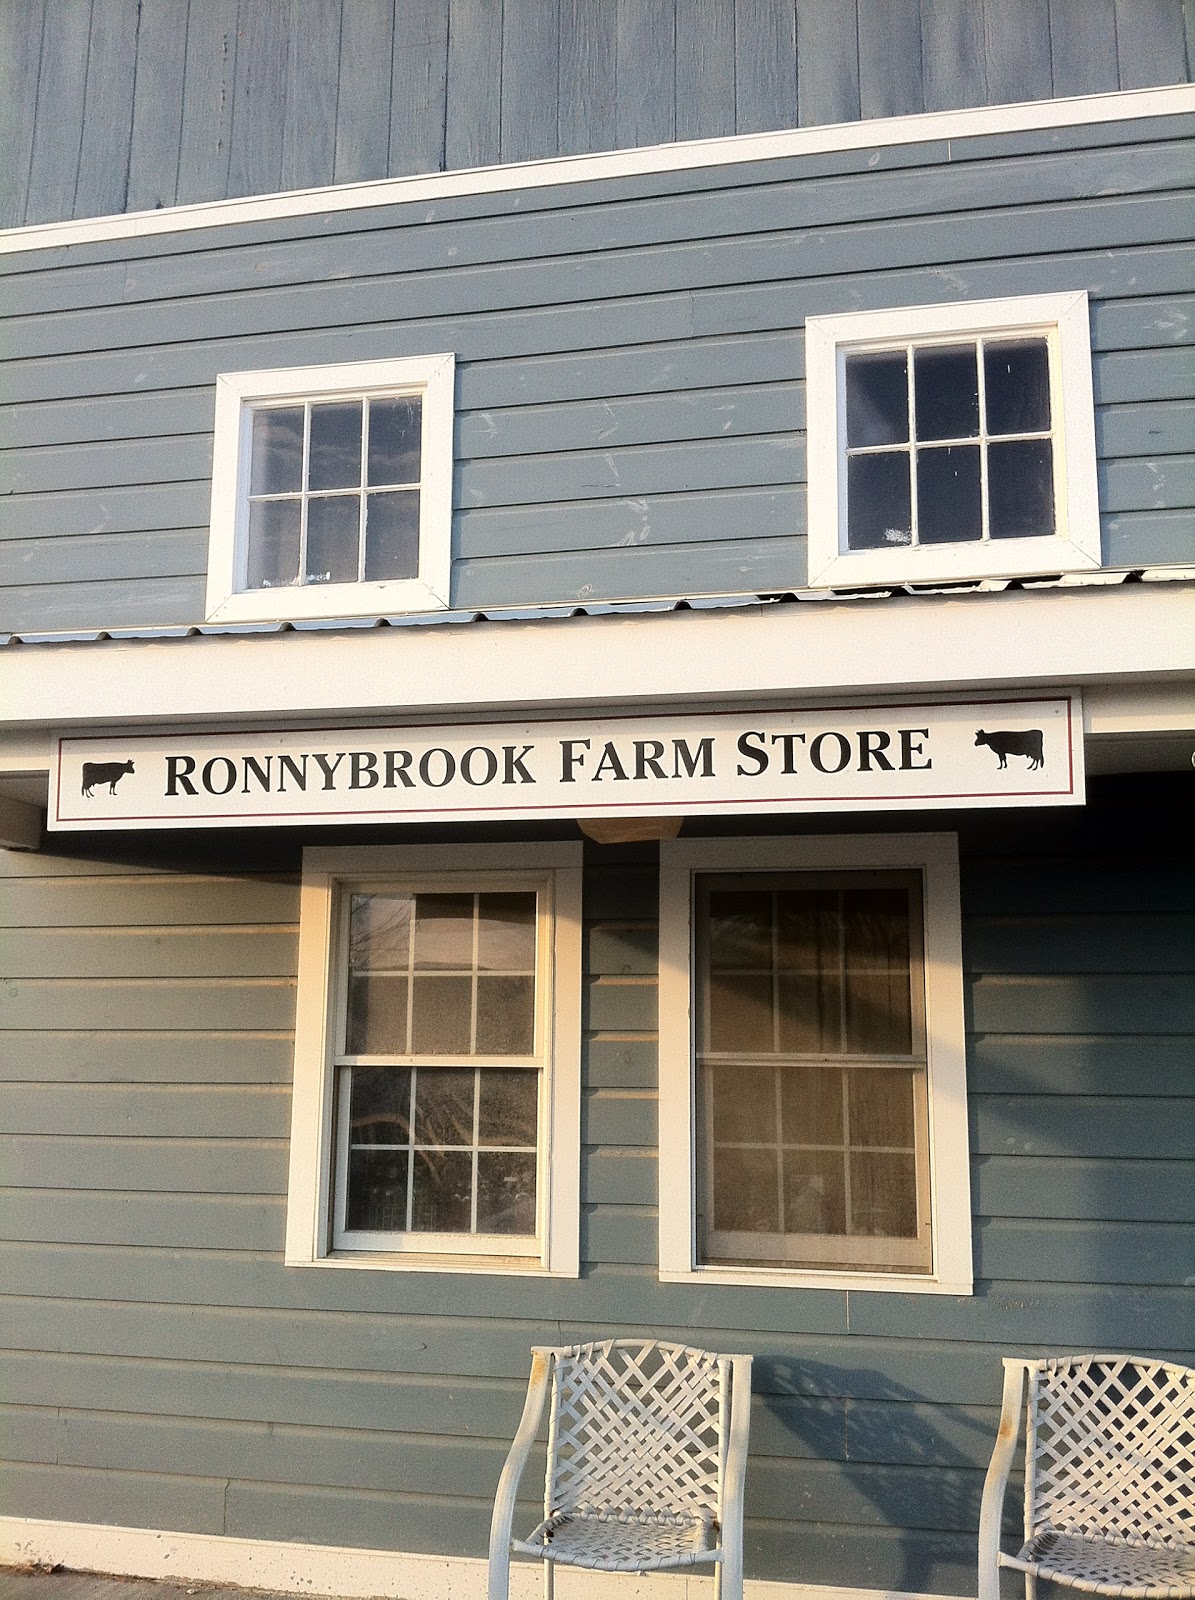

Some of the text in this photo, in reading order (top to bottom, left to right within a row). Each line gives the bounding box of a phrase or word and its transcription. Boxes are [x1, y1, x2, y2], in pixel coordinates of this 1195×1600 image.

[165, 729, 933, 797] RONNYBROOK FARM STORE
